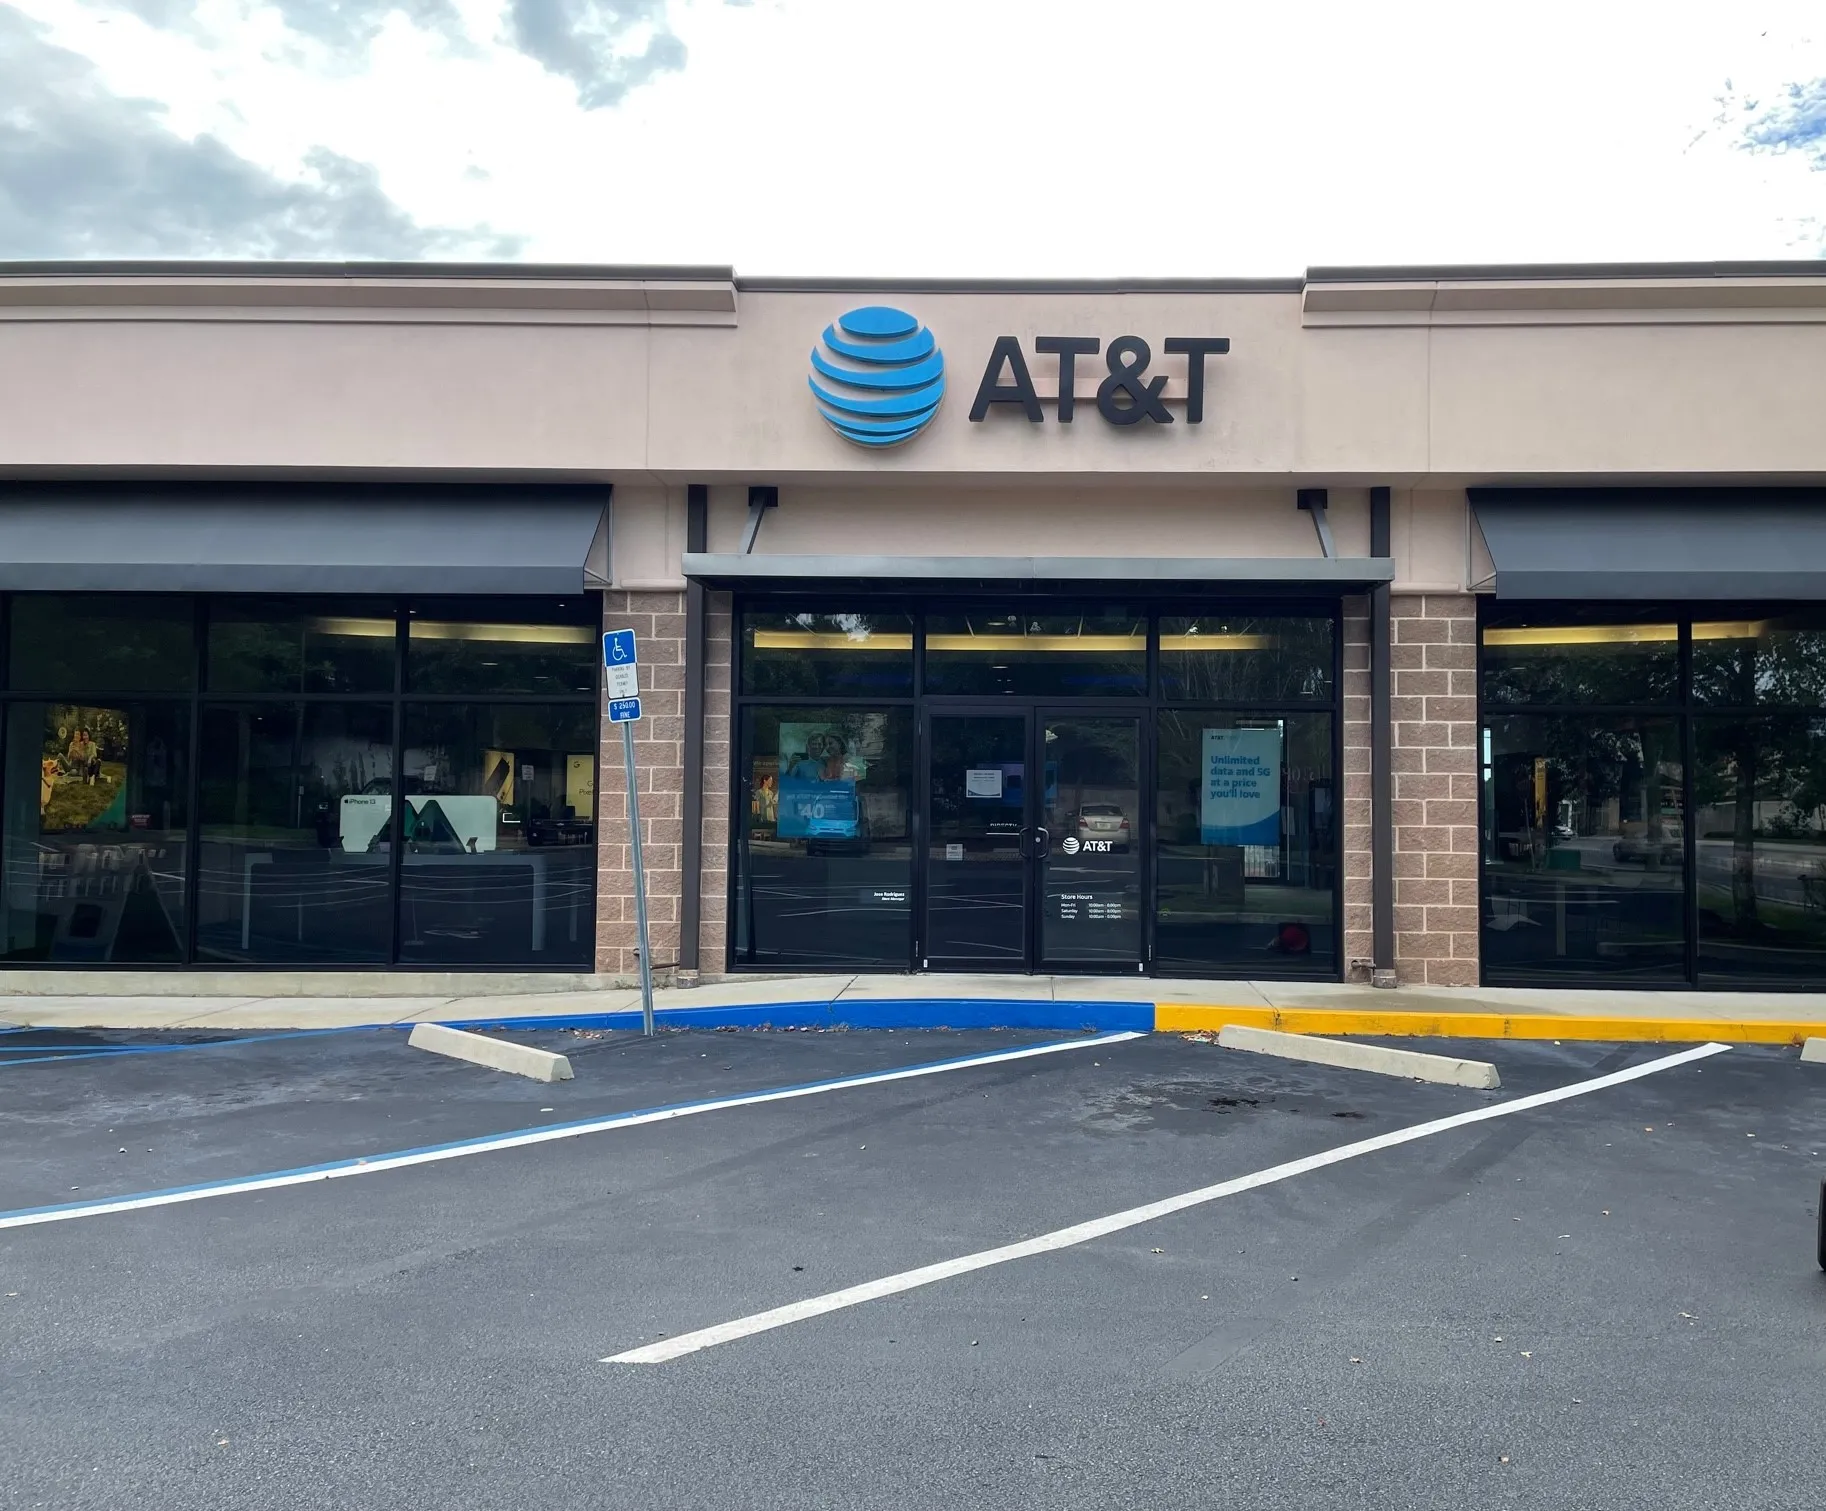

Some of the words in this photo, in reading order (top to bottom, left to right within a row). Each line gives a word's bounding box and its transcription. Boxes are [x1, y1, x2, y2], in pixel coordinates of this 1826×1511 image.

[969, 335, 1230, 425] AT&T
[620, 711, 631, 719] FINE
[1210, 755, 1260, 765] Unlimited
[1210, 766, 1234, 776] data
[1236, 767, 1255, 776] and
[1257, 767, 1271, 777] 5G
[1210, 778, 1221, 786] at
[1232, 778, 1257, 788] price
[1210, 788, 1237, 800] you'll
[1240, 788, 1261, 799] love
[1083, 840, 1113, 852] AT&T
